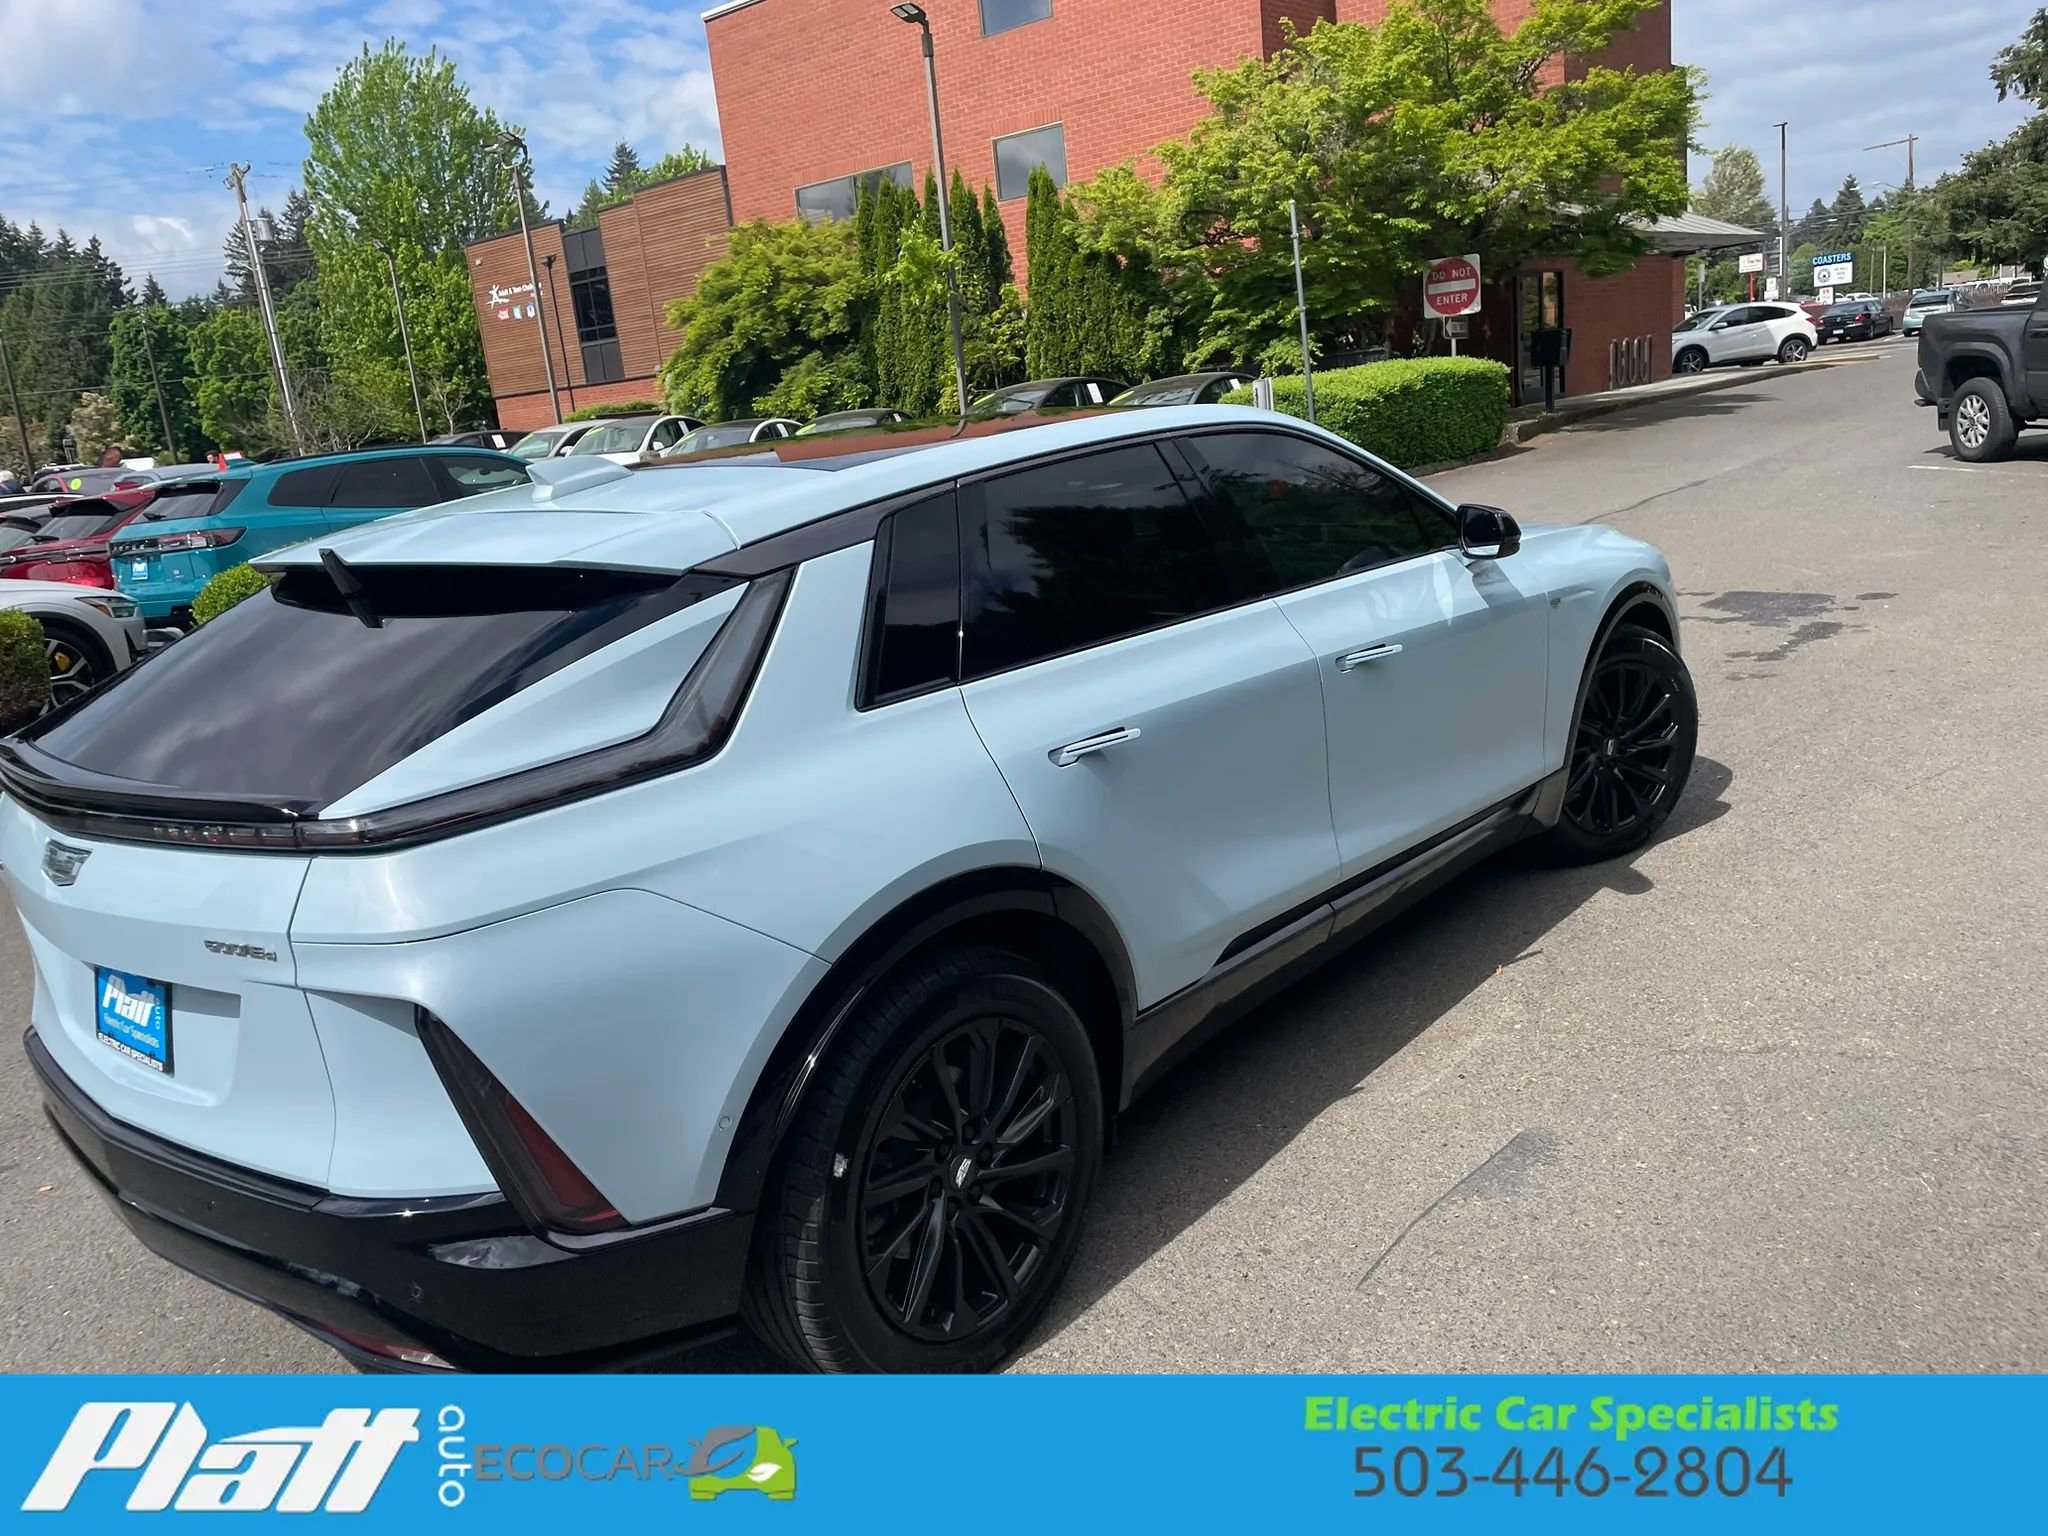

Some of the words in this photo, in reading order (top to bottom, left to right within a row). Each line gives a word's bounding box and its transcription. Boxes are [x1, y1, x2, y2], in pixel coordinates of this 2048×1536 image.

[1812, 252, 1852, 265] COASTERS
[1432, 271, 1446, 281] DO
[1452, 267, 1471, 278] NOT
[1436, 294, 1468, 305] ENTER
